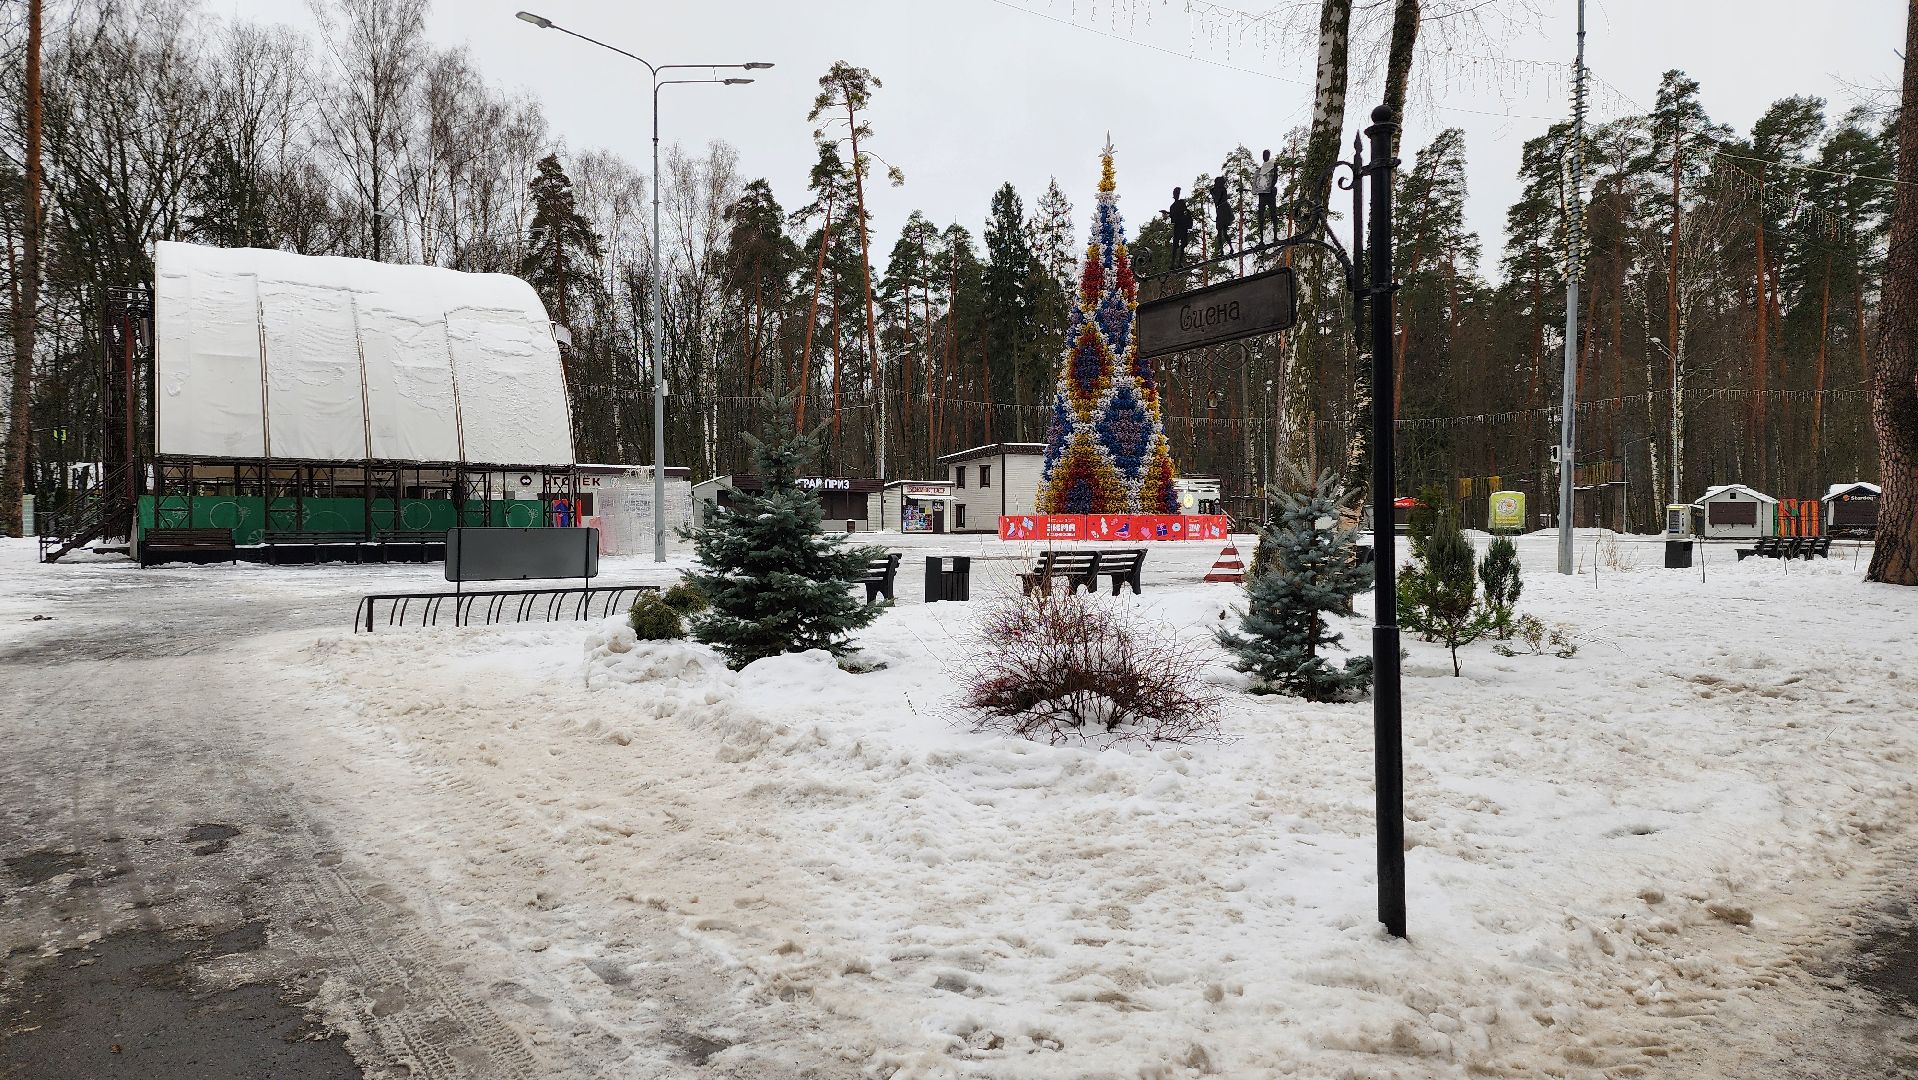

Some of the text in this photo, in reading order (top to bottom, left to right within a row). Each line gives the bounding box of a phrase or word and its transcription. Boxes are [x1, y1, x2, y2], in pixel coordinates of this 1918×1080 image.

[1179, 300, 1241, 332] Сцена
[544, 475, 601, 487] ГОЁК
[824, 478, 850, 490] ПРИЗ
